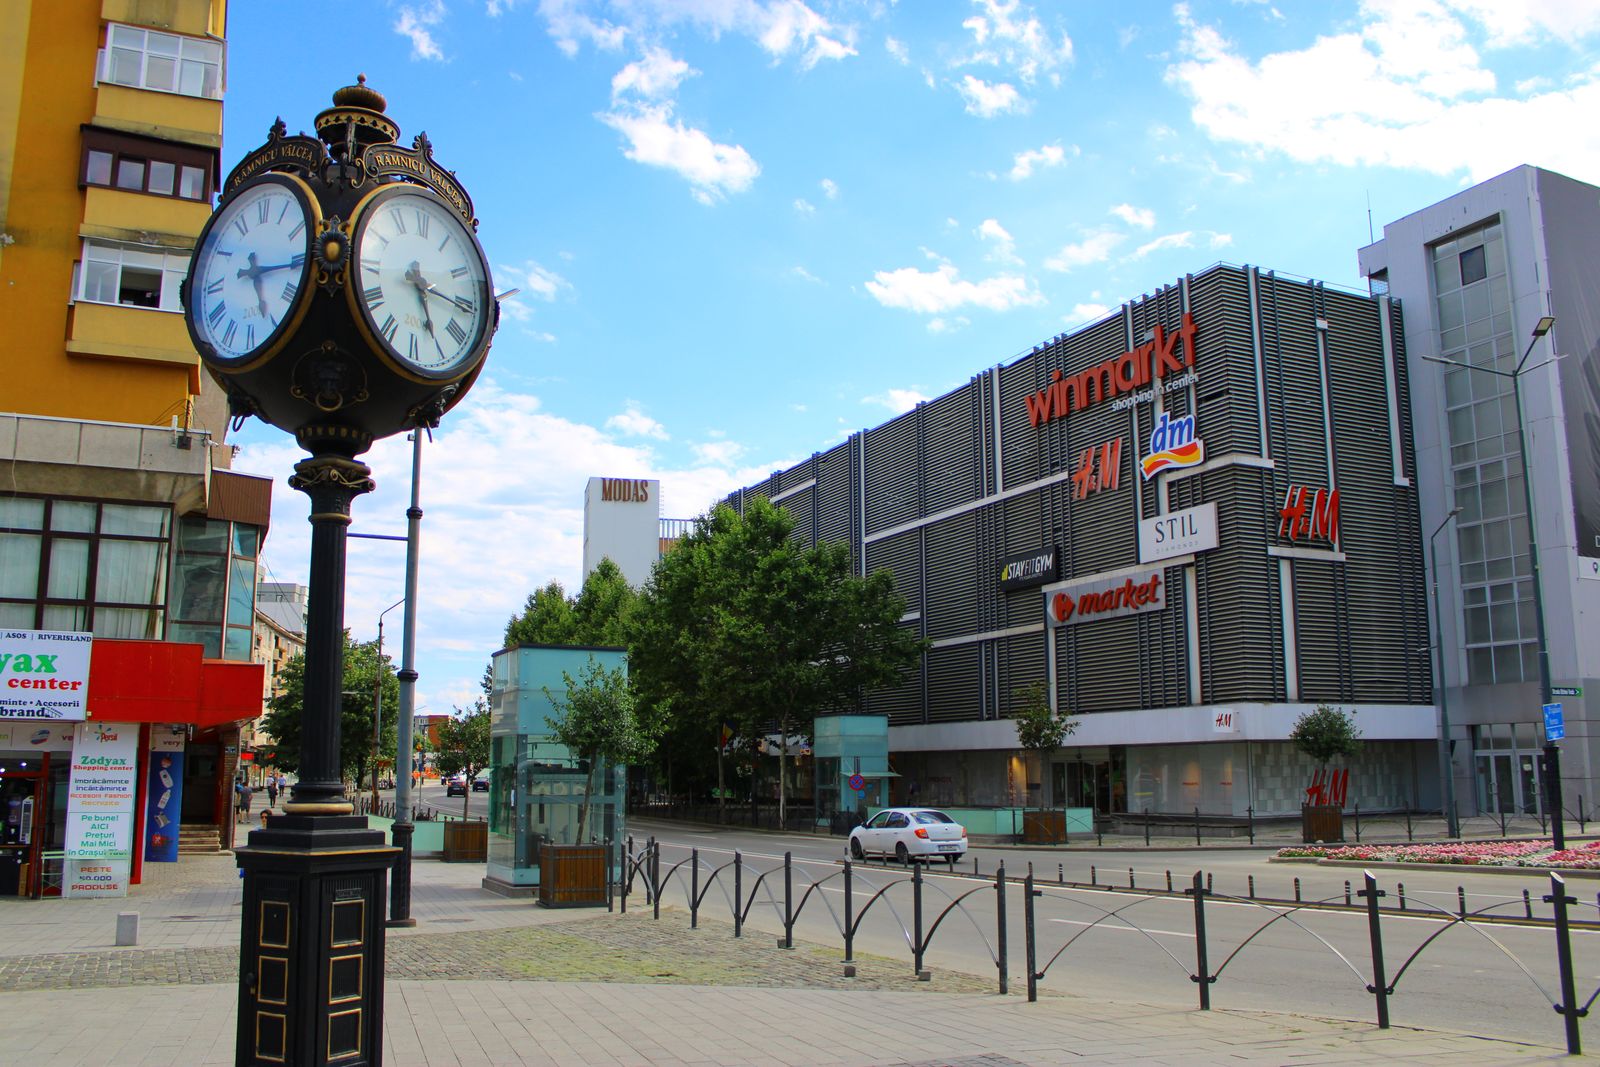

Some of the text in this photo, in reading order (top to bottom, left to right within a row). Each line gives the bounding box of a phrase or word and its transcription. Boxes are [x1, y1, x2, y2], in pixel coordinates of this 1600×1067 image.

[281, 144, 313, 160] VÂLCEA
[375, 152, 463, 208] RÂMNICU VÂLCEA
[1024, 312, 1198, 428] winmarkt
[1111, 372, 1200, 413] shopping in center
[1152, 413, 1195, 454] dm
[1072, 437, 1123, 500] H&M
[601, 478, 648, 502] MODAS
[1155, 514, 1198, 544] STIL
[1278, 484, 1340, 544] H&M
[1077, 574, 1162, 616] market
[38, 633, 92, 642] RIVERISLAND
[8, 677, 82, 690] center
[1215, 713, 1232, 727] H&M
[81, 756, 127, 766] Zodyax
[1306, 768, 1348, 809] H&M
